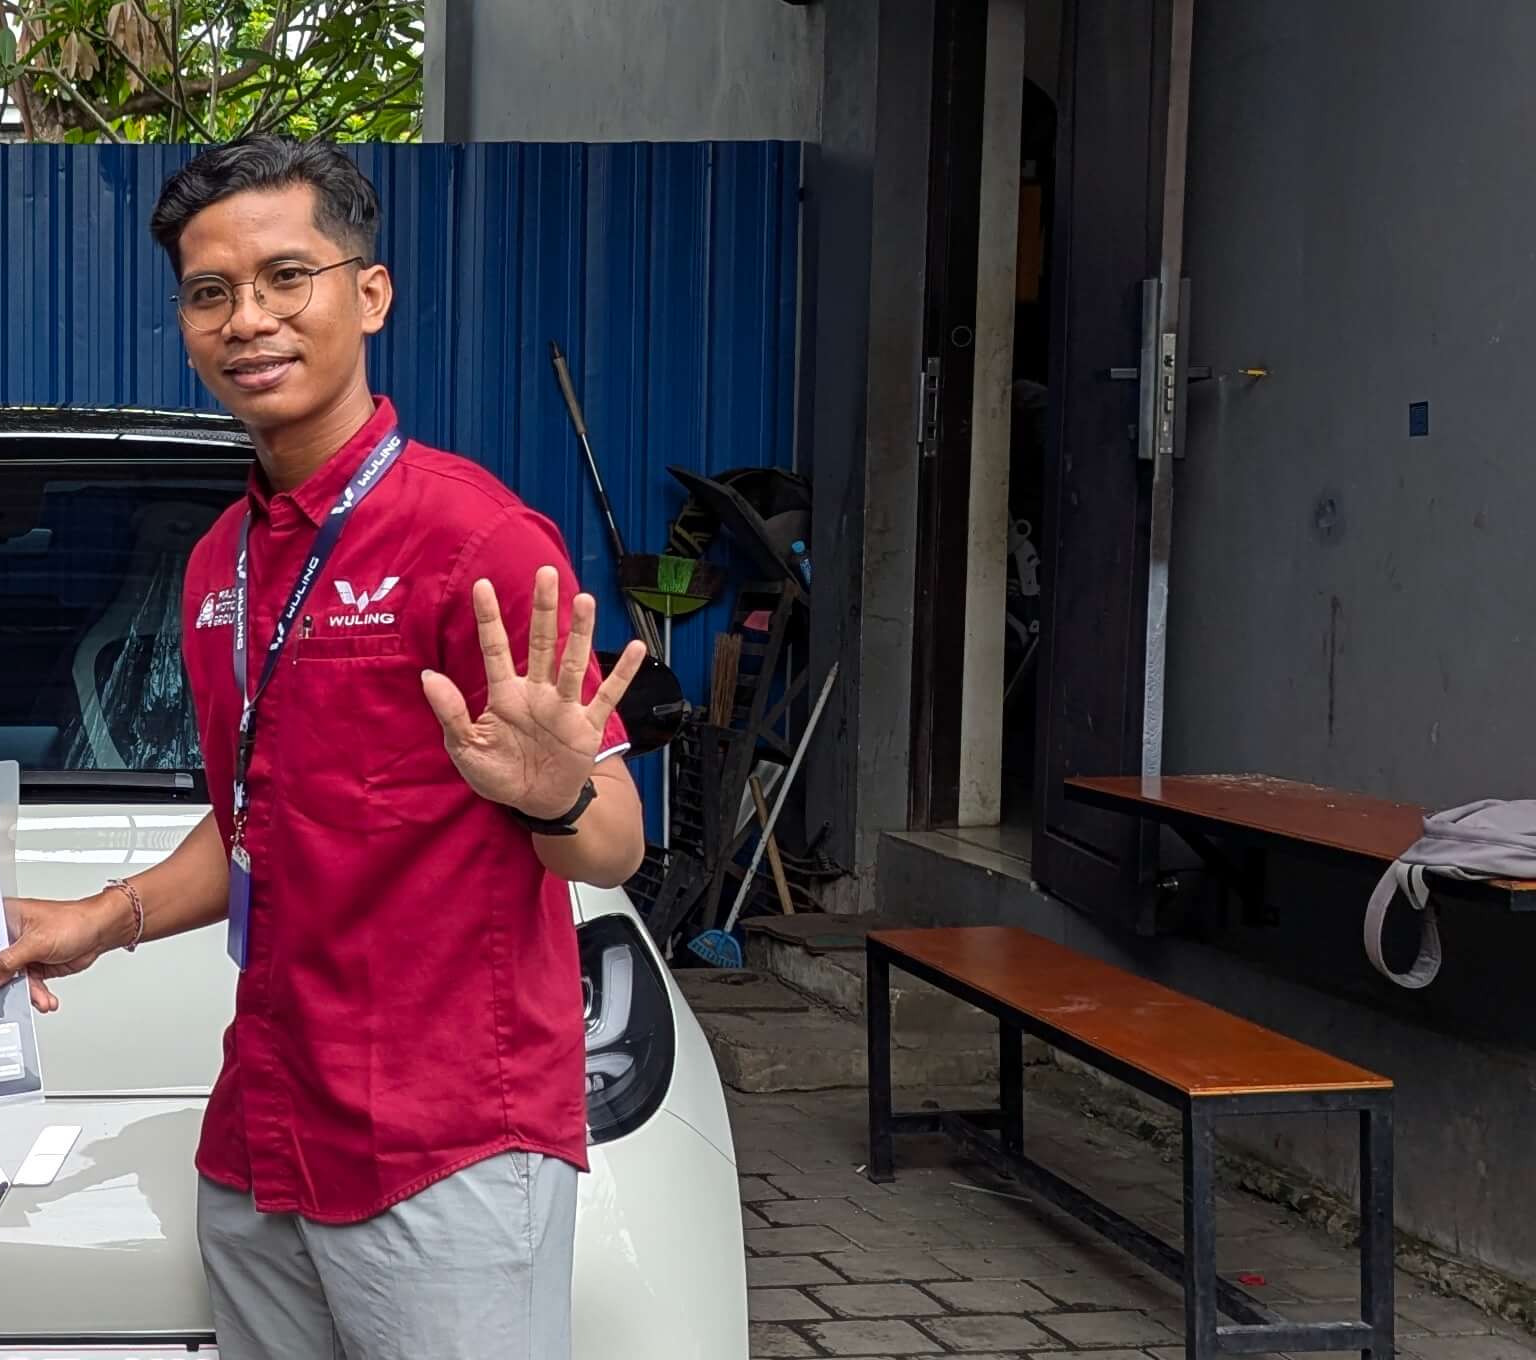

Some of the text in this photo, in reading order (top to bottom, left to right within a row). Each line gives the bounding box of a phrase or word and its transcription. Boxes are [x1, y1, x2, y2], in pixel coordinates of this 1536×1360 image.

[358, 436, 401, 487] WULING
[286, 556, 319, 619] WULING
[213, 613, 236, 626] GROU
[329, 612, 395, 627] WULING
